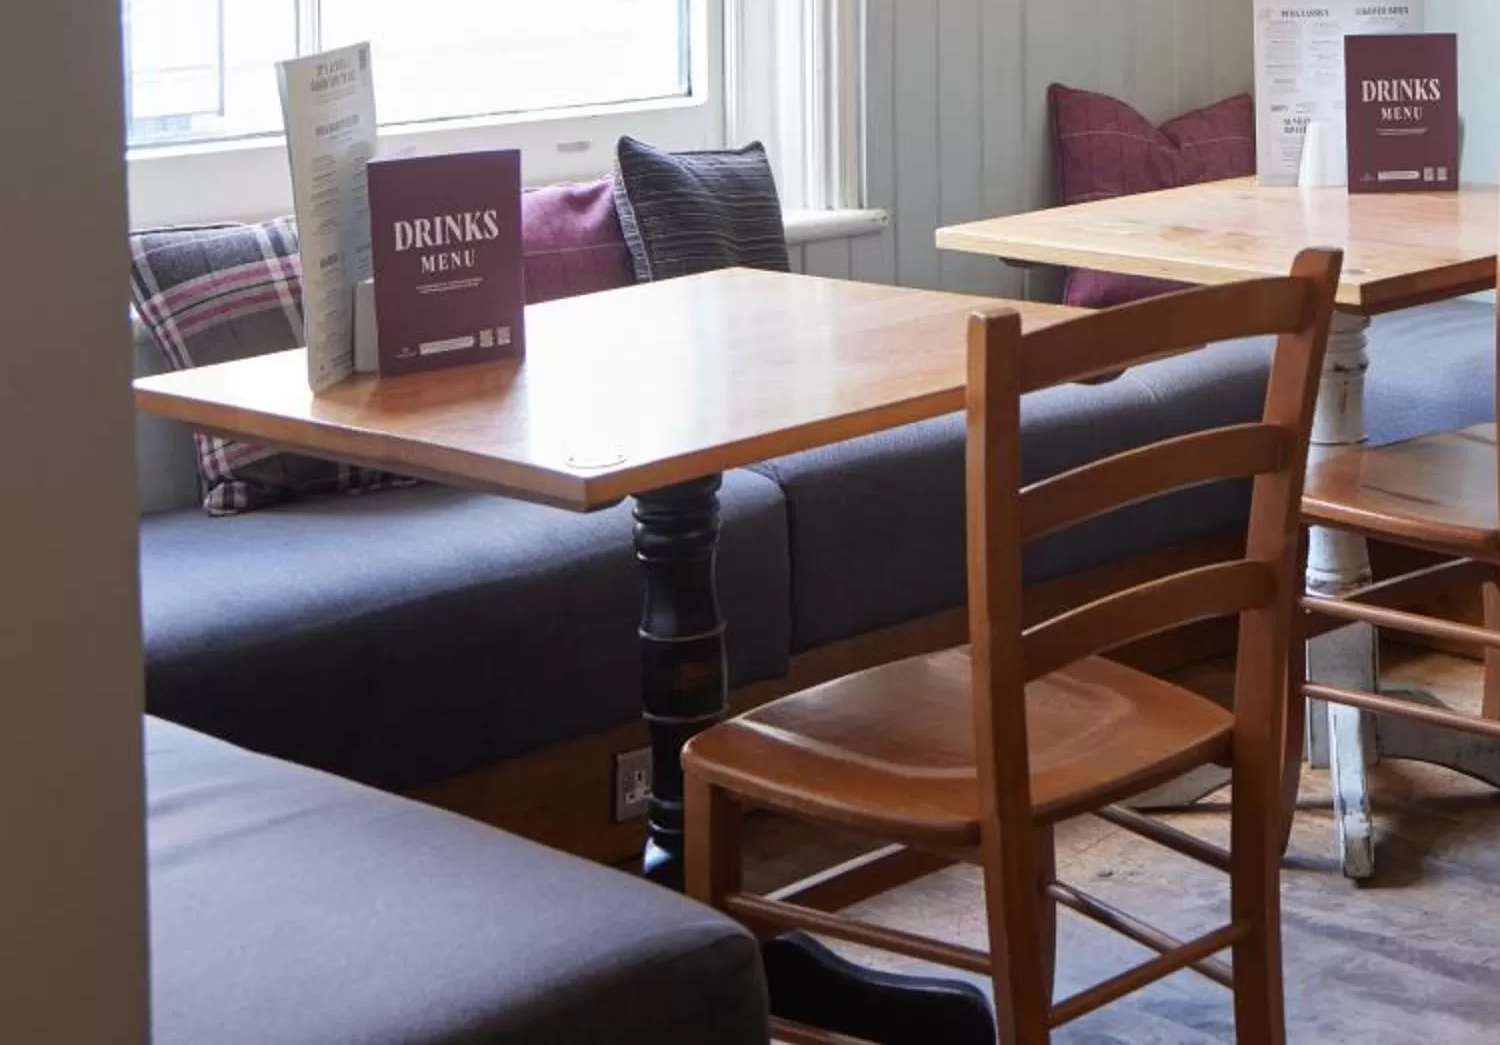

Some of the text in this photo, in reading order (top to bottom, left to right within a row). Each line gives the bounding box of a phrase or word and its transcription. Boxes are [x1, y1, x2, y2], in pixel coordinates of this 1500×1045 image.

[1361, 78, 1441, 102] DRINKS
[1381, 106, 1423, 121] MENU
[393, 209, 499, 251] DRINKS
[421, 249, 476, 273] MENU
